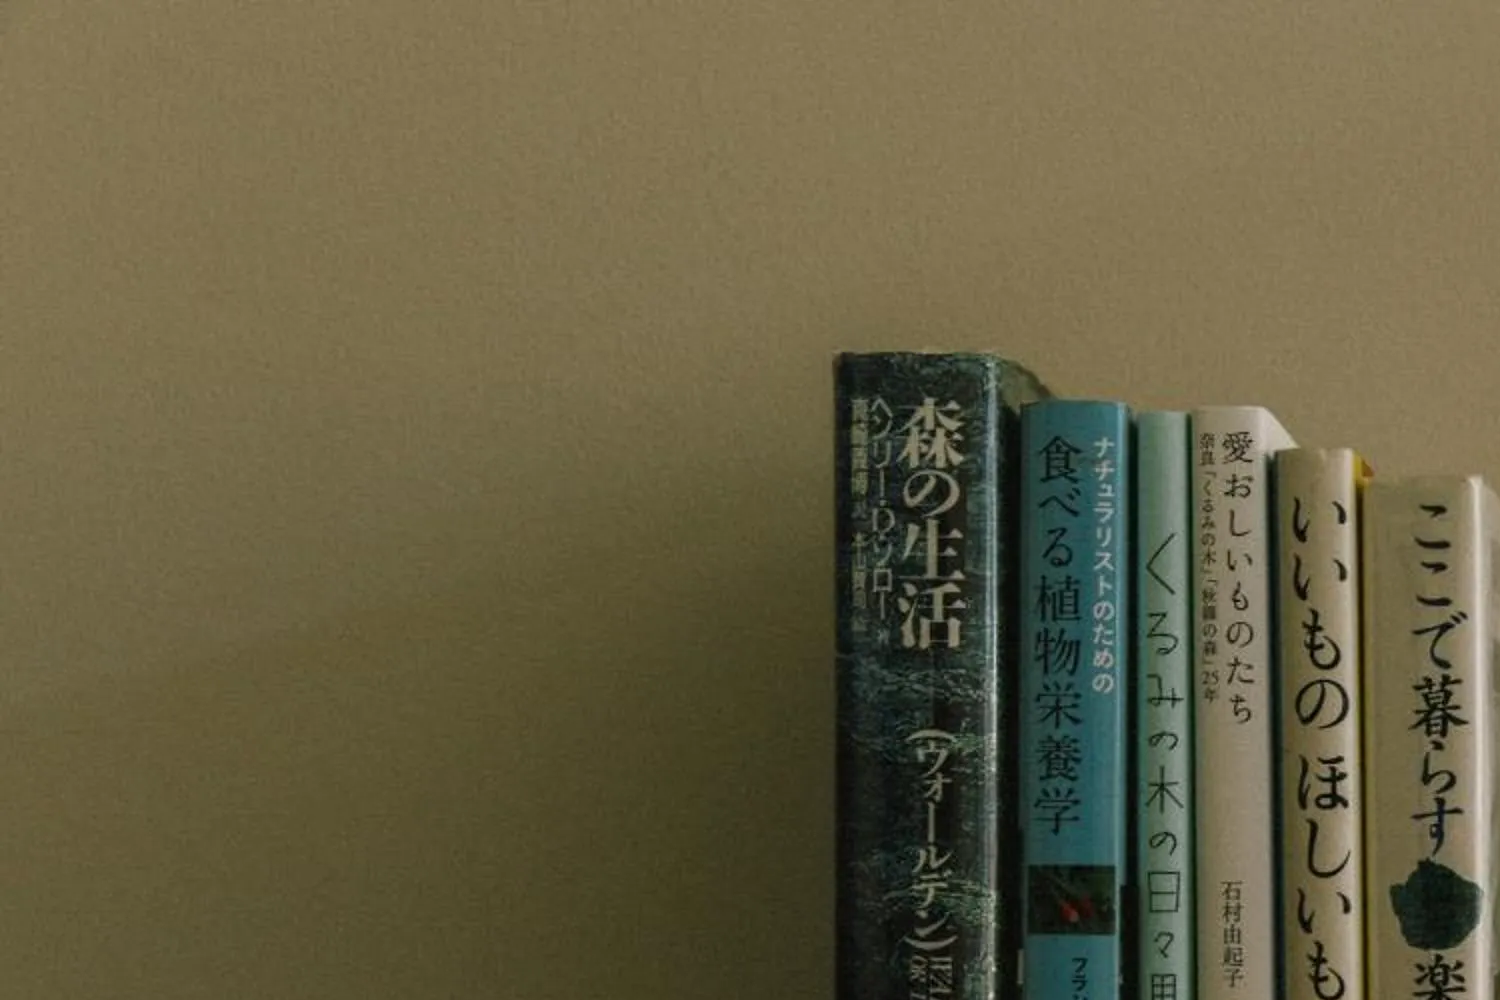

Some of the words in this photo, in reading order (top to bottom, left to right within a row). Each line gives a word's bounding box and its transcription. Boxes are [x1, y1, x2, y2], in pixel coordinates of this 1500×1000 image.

[896, 397, 966, 649] 森の生活
[1033, 435, 1083, 836] 食べる植物栄養学
[1092, 437, 1115, 693] ナチュラリストのための
[1222, 431, 1256, 724] 愛おしいものたち
[1408, 505, 1470, 856] ここで暮らす
[1221, 880, 1245, 988] 石村由起子
